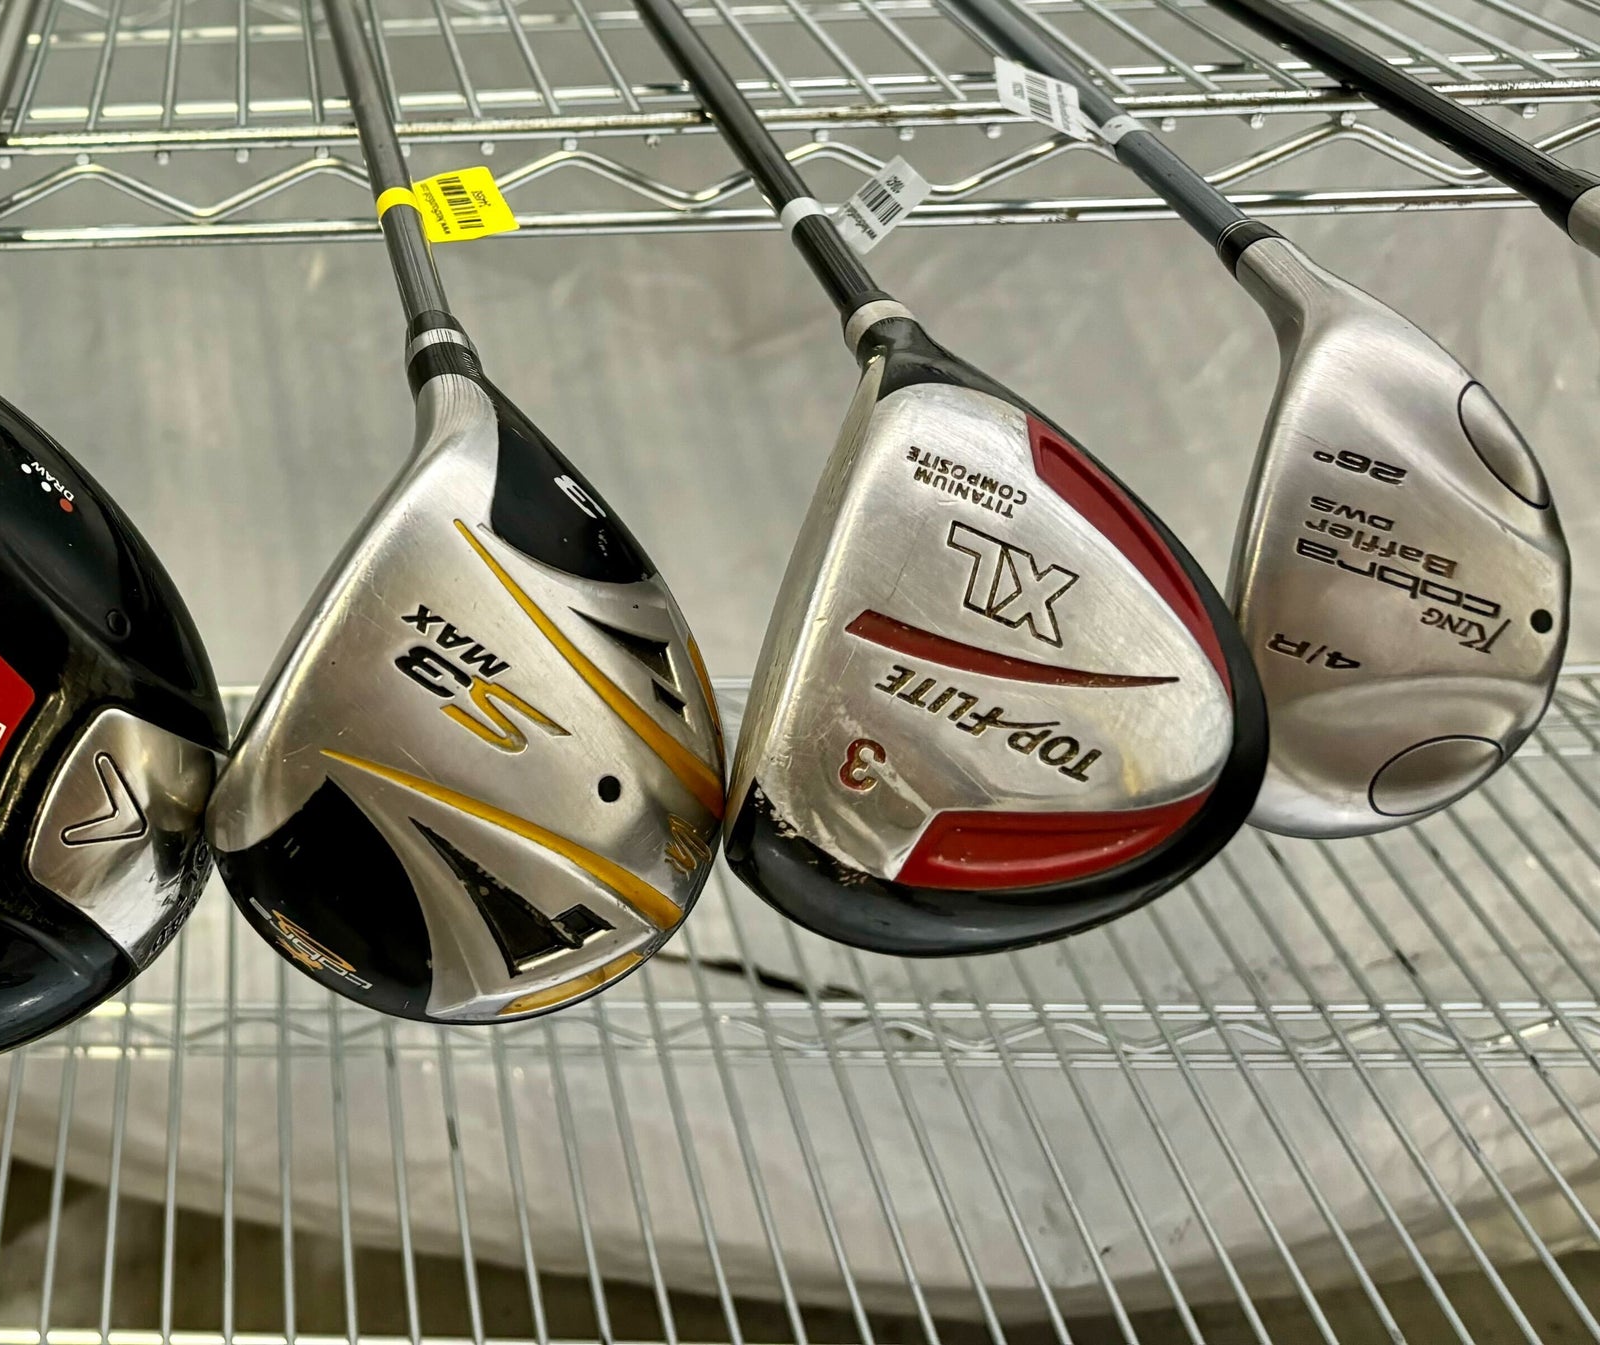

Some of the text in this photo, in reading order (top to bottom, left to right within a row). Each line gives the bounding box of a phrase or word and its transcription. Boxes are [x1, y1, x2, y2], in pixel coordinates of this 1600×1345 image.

[30, 461, 74, 501] DRAW
[553, 474, 607, 519] 3
[906, 445, 1028, 505] COMPOSITE
[913, 466, 1014, 519] TITANIUM
[1309, 496, 1395, 531] DWS
[1304, 518, 1458, 579] Baffler
[947, 519, 1080, 649] XL
[1296, 537, 1502, 619] cobra
[401, 603, 511, 678] MAX
[1266, 633, 1361, 670] 4/R
[1419, 606, 1512, 654] KING
[394, 645, 573, 755] S3
[838, 737, 887, 792] 3
